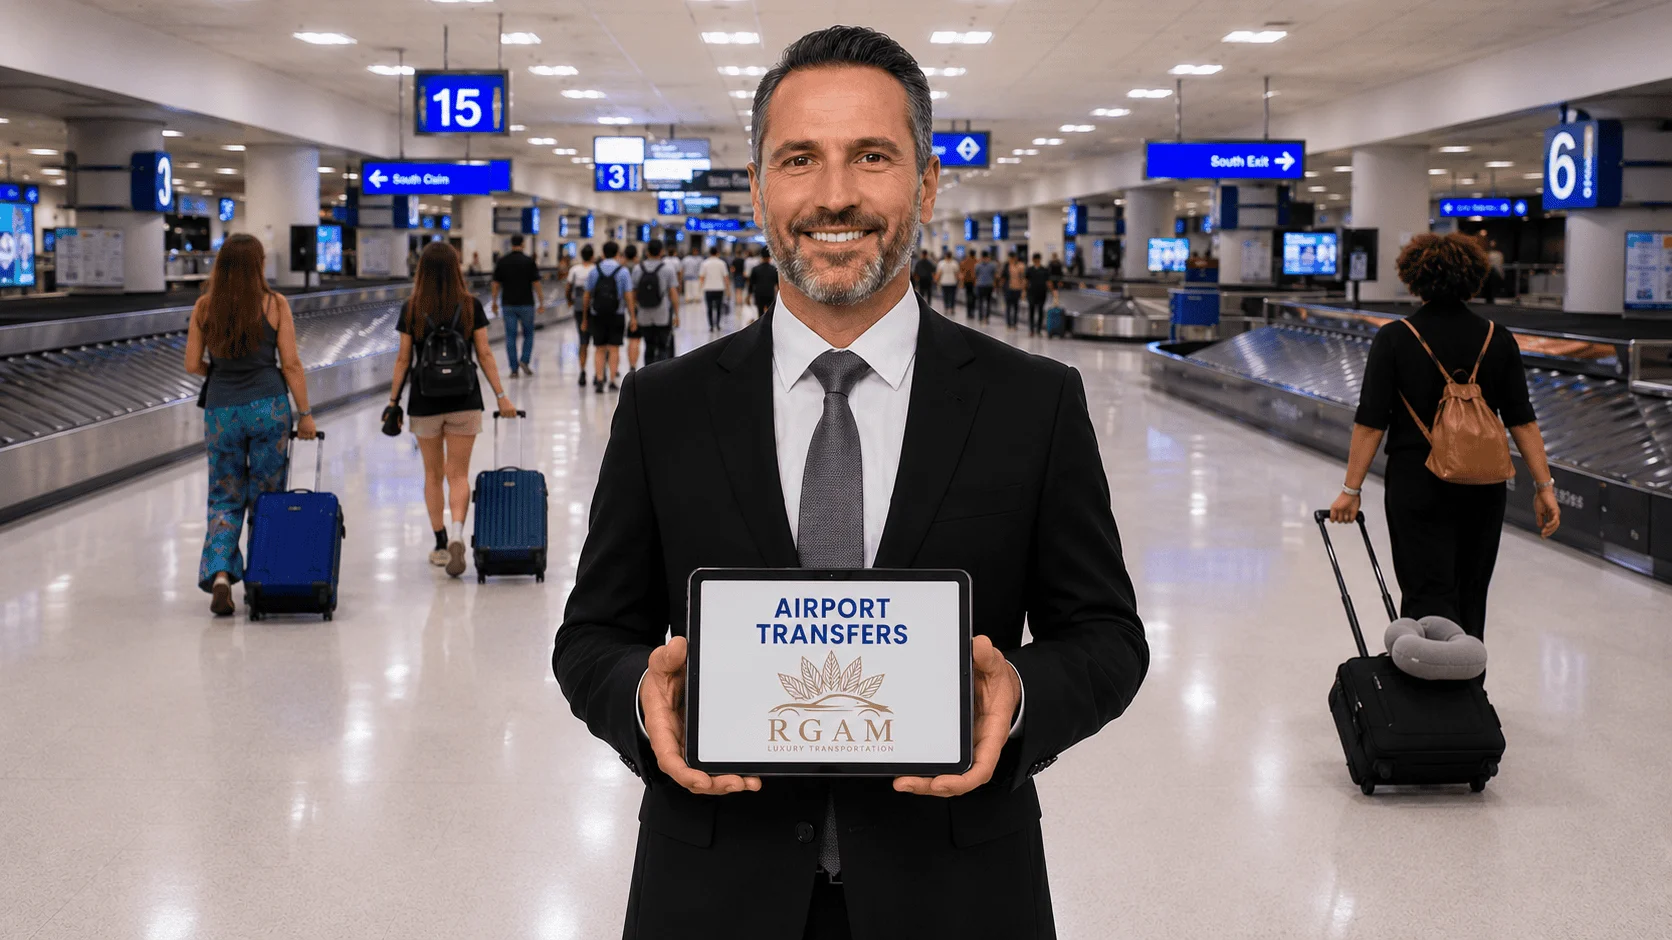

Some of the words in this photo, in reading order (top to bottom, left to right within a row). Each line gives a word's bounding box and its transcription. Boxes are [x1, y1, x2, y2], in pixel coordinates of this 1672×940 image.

[432, 88, 482, 127] 15
[1210, 154, 1245, 168] South
[1247, 154, 1270, 168] Exit
[1549, 131, 1577, 200] 6
[392, 173, 422, 185] South
[608, 164, 626, 189] 3
[664, 199, 675, 213] 3
[774, 597, 891, 619] AIRPORT
[756, 623, 908, 645] TRANSFERS
[767, 718, 894, 742] RGAM
